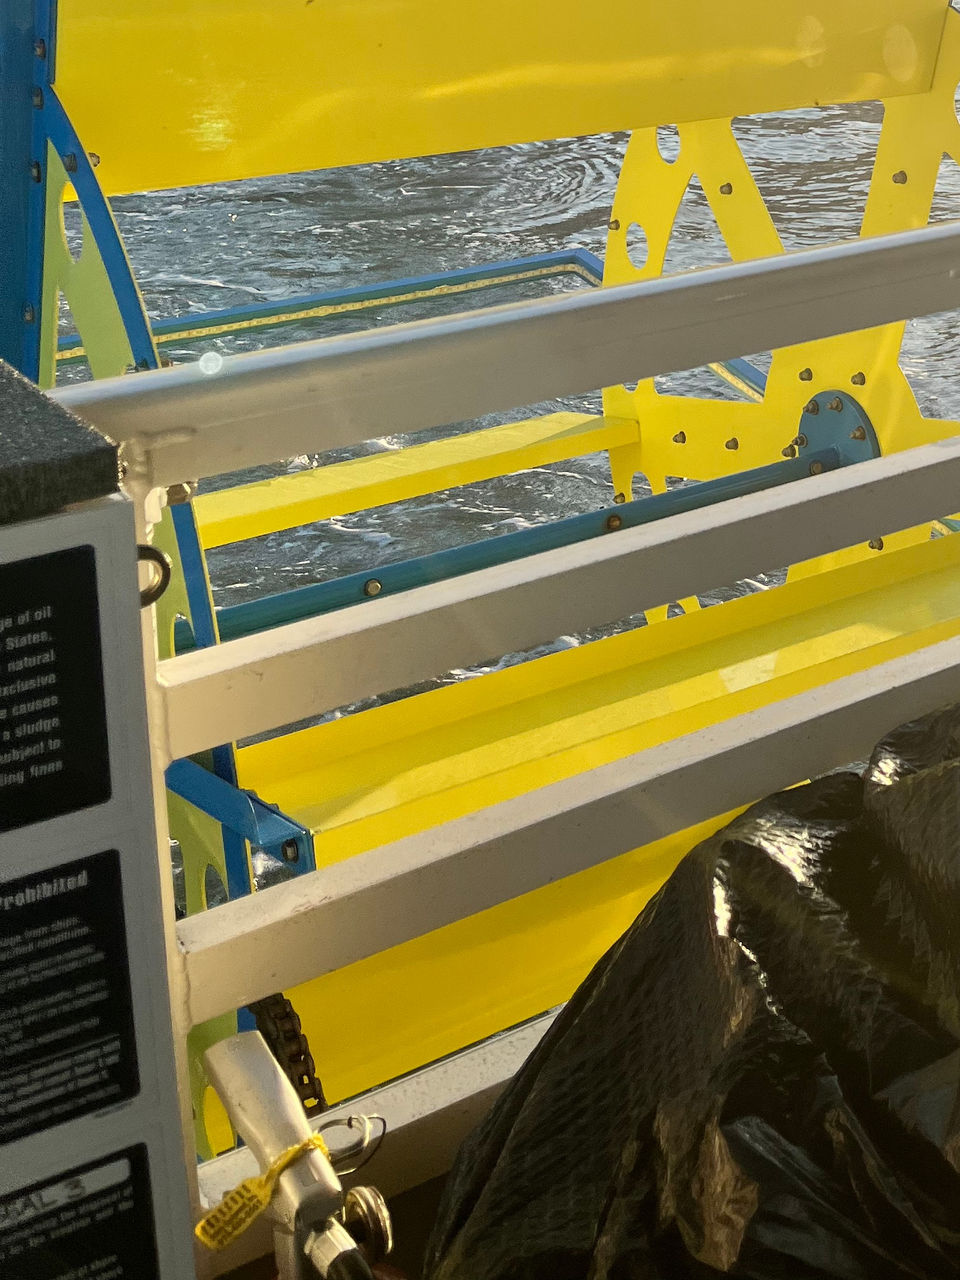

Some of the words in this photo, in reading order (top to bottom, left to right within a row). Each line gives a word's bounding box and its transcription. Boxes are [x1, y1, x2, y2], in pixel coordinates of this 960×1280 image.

[34, 606, 52, 621] oil
[7, 649, 55, 672] natural
[0, 674, 56, 697] xclusive
[12, 696, 58, 716] causes
[15, 718, 59, 738] sludge
[0, 870, 88, 908] rohibited
